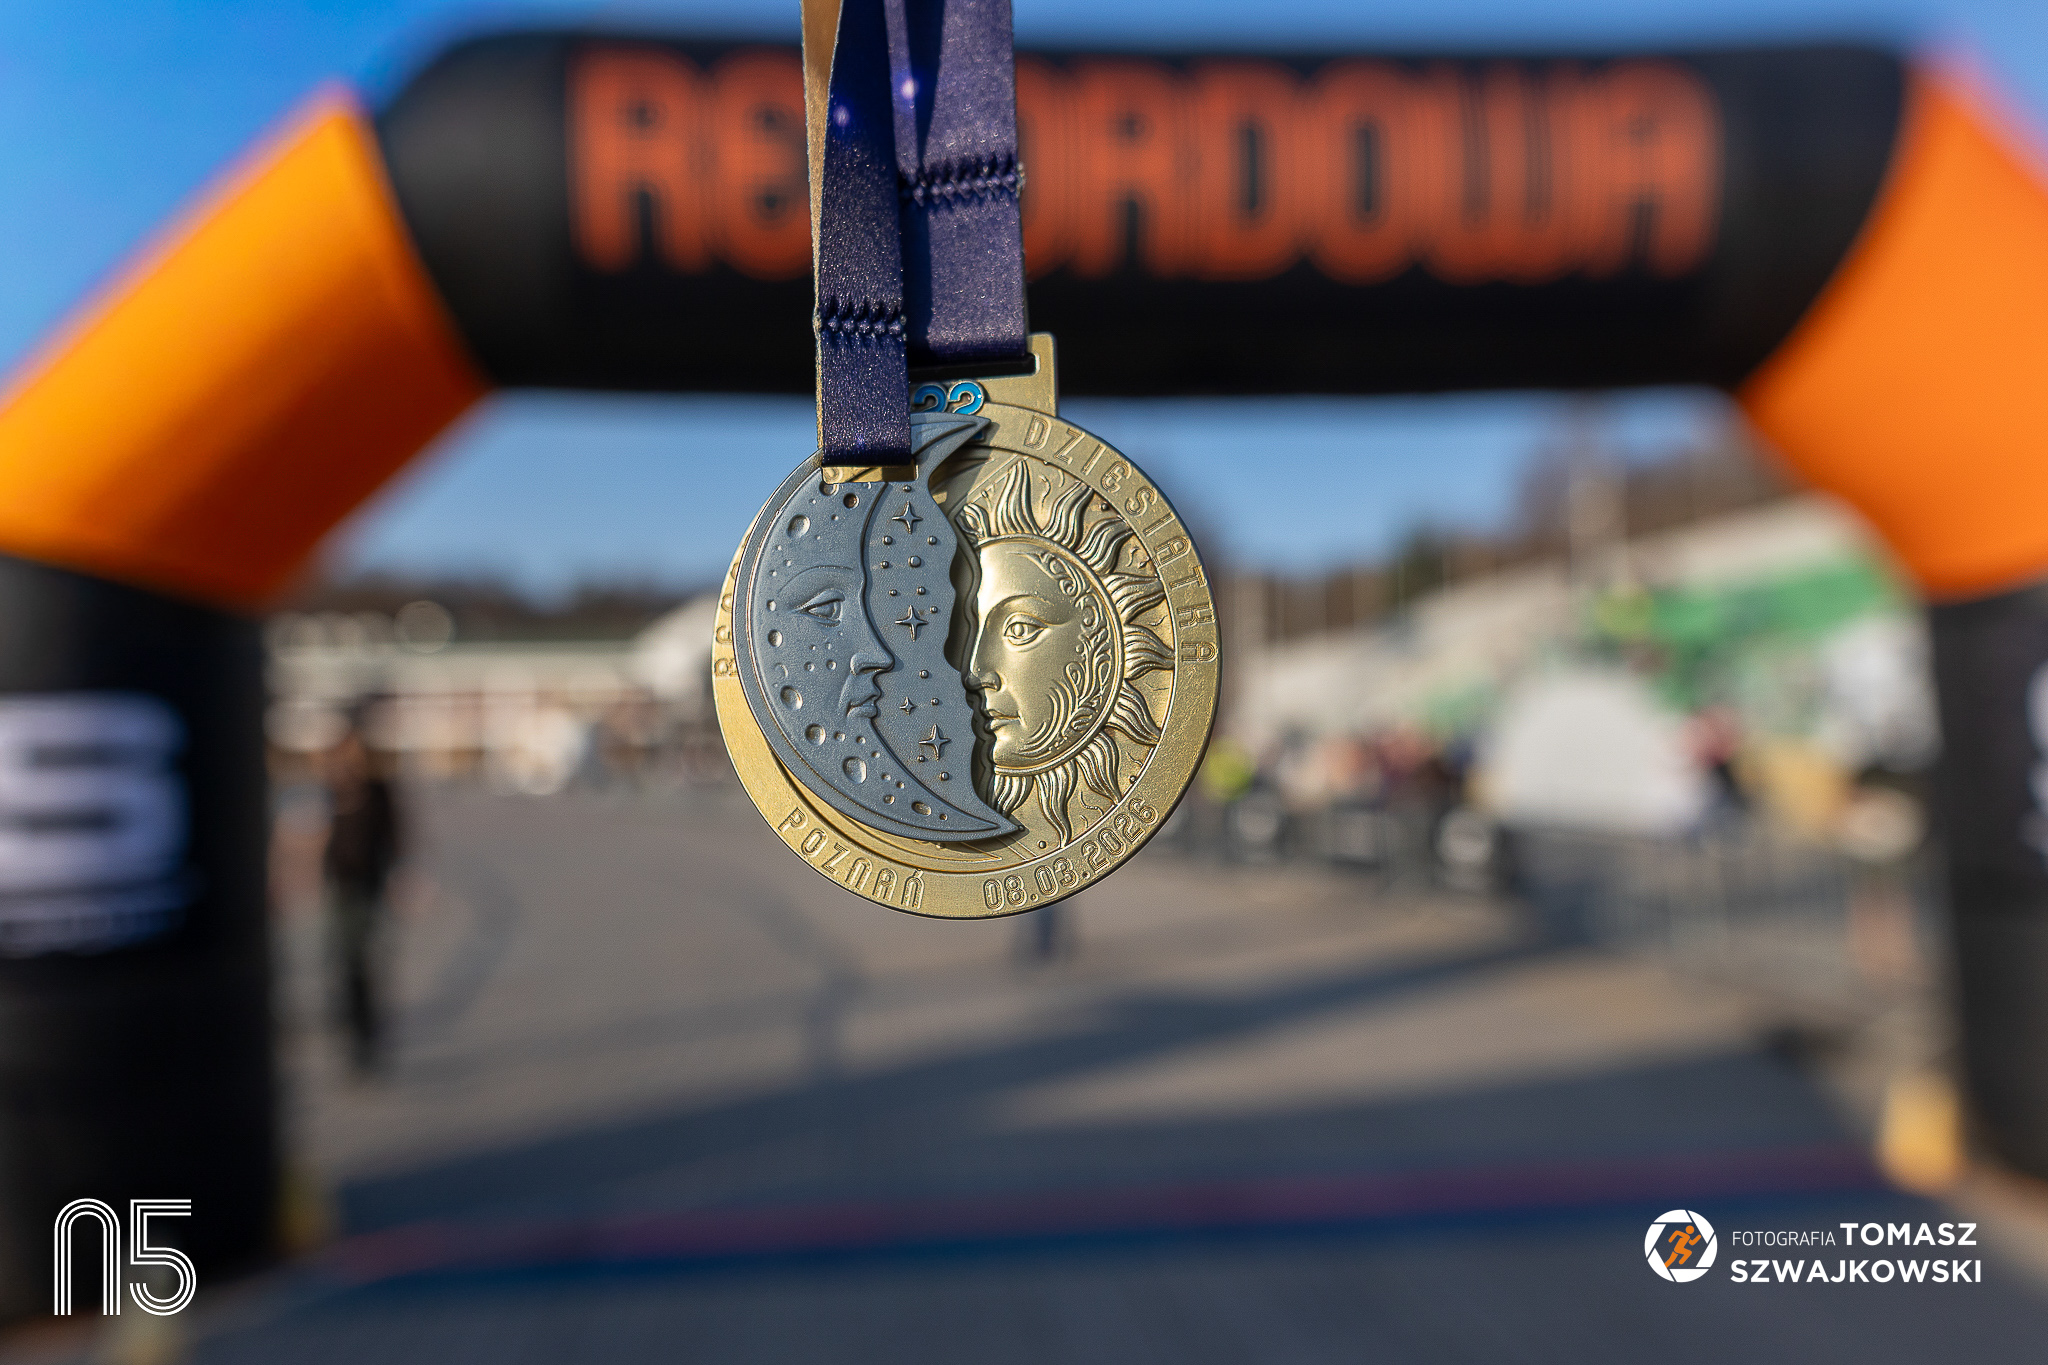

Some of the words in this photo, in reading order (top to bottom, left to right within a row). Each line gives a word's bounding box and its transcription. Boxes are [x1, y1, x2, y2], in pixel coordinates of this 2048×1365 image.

[564, 44, 1722, 284] REORDOWA
[777, 805, 925, 910] POZNAŃ
[982, 798, 1160, 912] 08.03.2026
